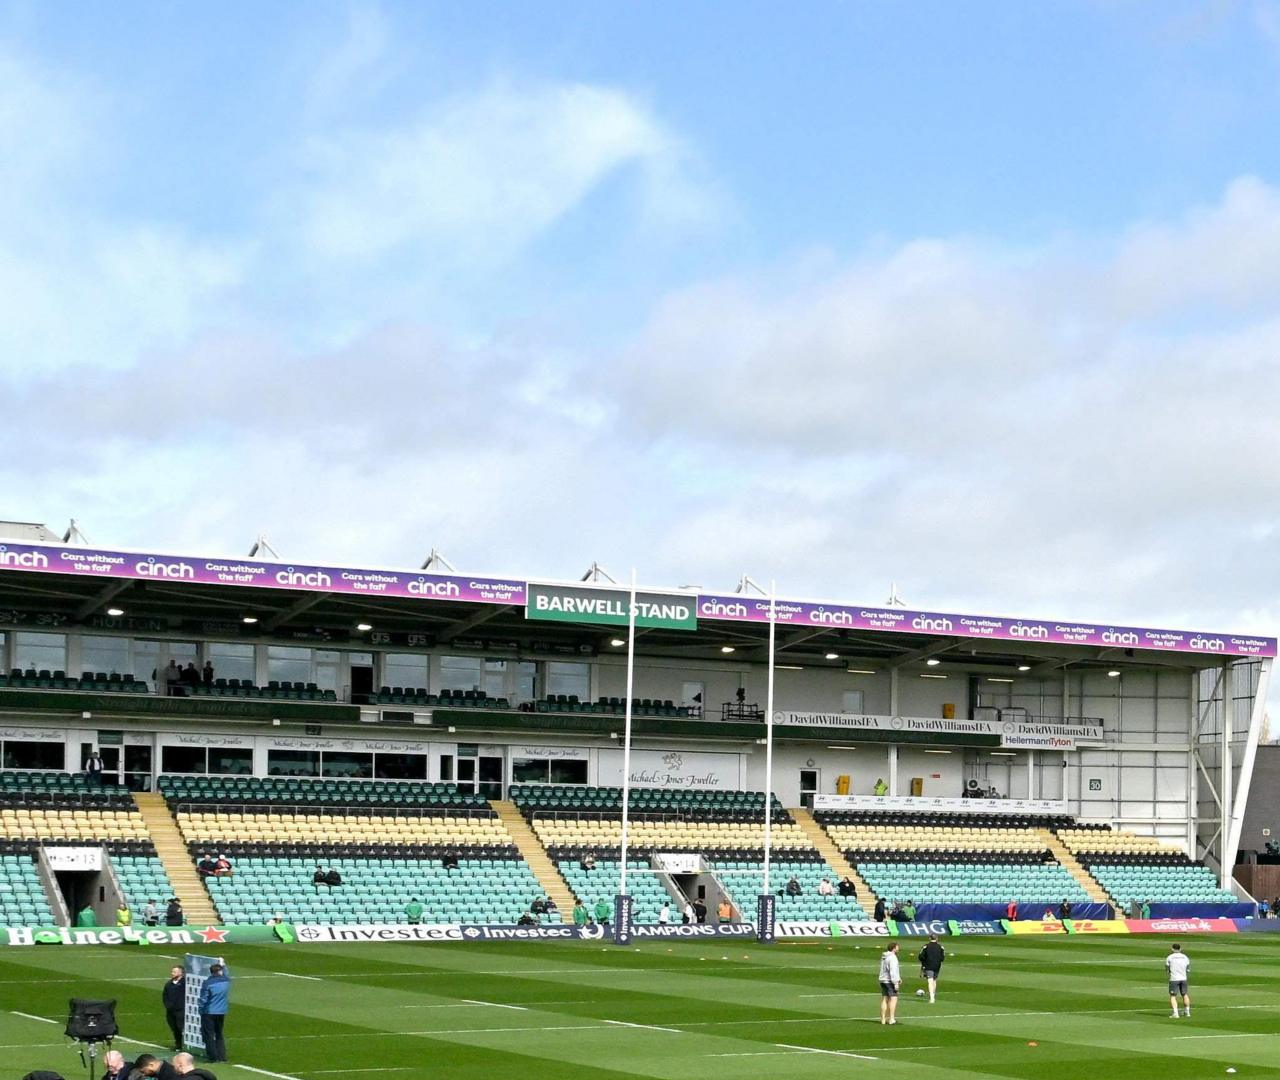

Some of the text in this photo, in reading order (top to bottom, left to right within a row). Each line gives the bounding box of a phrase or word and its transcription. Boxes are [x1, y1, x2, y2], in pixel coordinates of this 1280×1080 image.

[61, 552, 124, 564] Cars without
[74, 562, 112, 573] the faff
[136, 556, 194, 578] cinch
[206, 563, 265, 575] Cars without
[219, 573, 254, 582] the faff
[276, 566, 331, 587] cinch
[408, 577, 460, 596] cinch
[470, 582, 523, 592] Cars without
[480, 591, 512, 600] the faff
[536, 595, 689, 620] BARWELL STAND
[702, 598, 746, 616] cinch
[810, 606, 852, 624] cinch
[912, 614, 952, 631] cinch
[1010, 621, 1048, 638] cinch
[1102, 628, 1138, 644] cinch
[1190, 634, 1224, 650] cinch
[790, 714, 1098, 737] DavidWilliamsIFA DavidWilliamsIFA DavidWilliamsIFA
[1006, 736, 1072, 746] HellermannTyton
[661, 773, 684, 786] Jones
[685, 774, 720, 786] Jeweller
[1090, 781, 1100, 790] 30
[327, 926, 464, 940] Investec
[482, 926, 571, 938] Investec
[718, 924, 752, 935] CUP
[904, 922, 944, 934] IHG
[1152, 922, 1197, 931] Georgia
